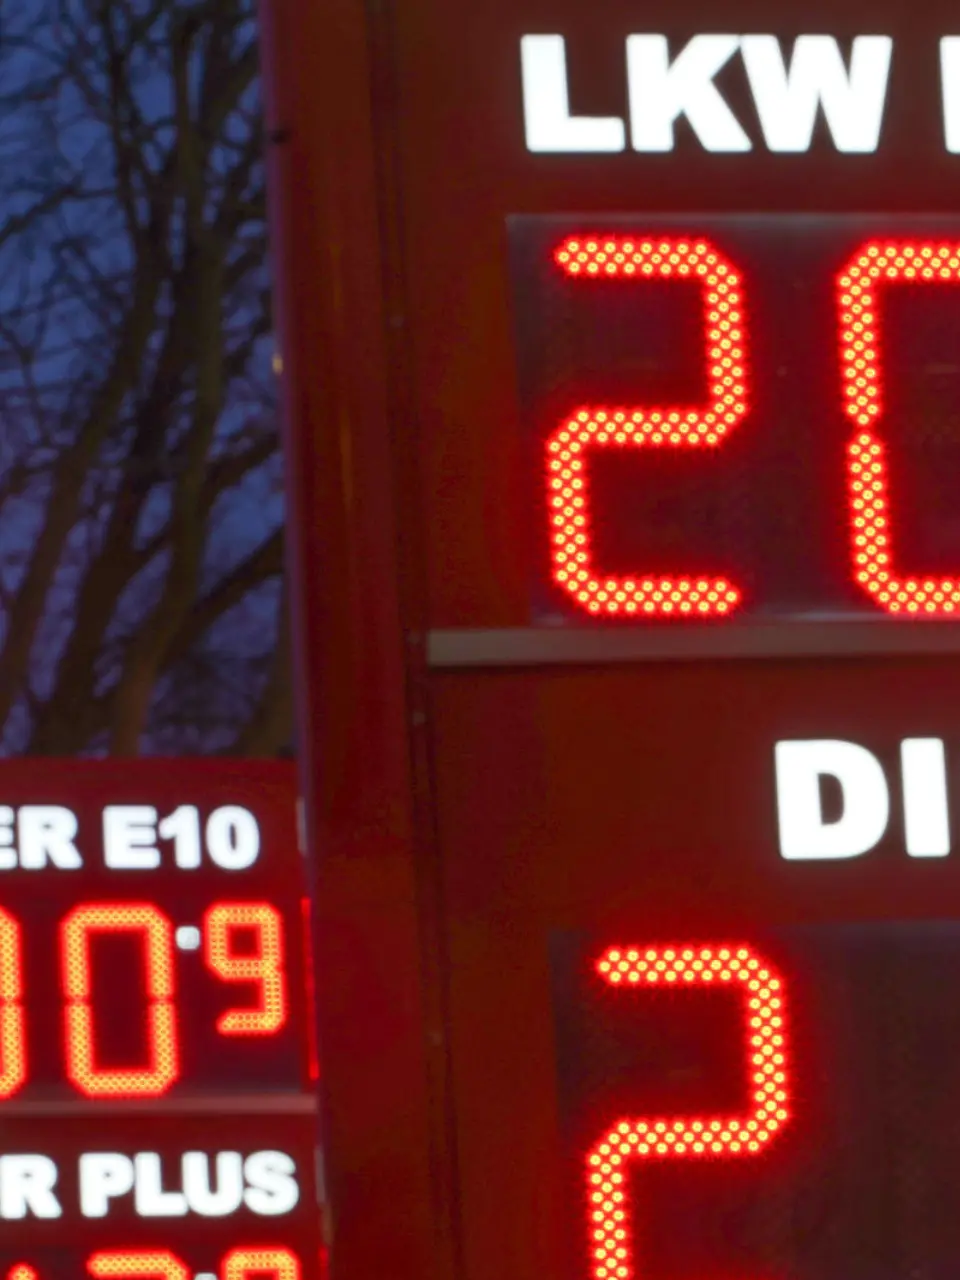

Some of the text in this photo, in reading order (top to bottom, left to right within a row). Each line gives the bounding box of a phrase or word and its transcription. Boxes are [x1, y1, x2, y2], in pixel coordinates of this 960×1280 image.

[521, 35, 892, 152] LKW
[104, 806, 259, 869] E10
[80, 1151, 298, 1217] PLUS
